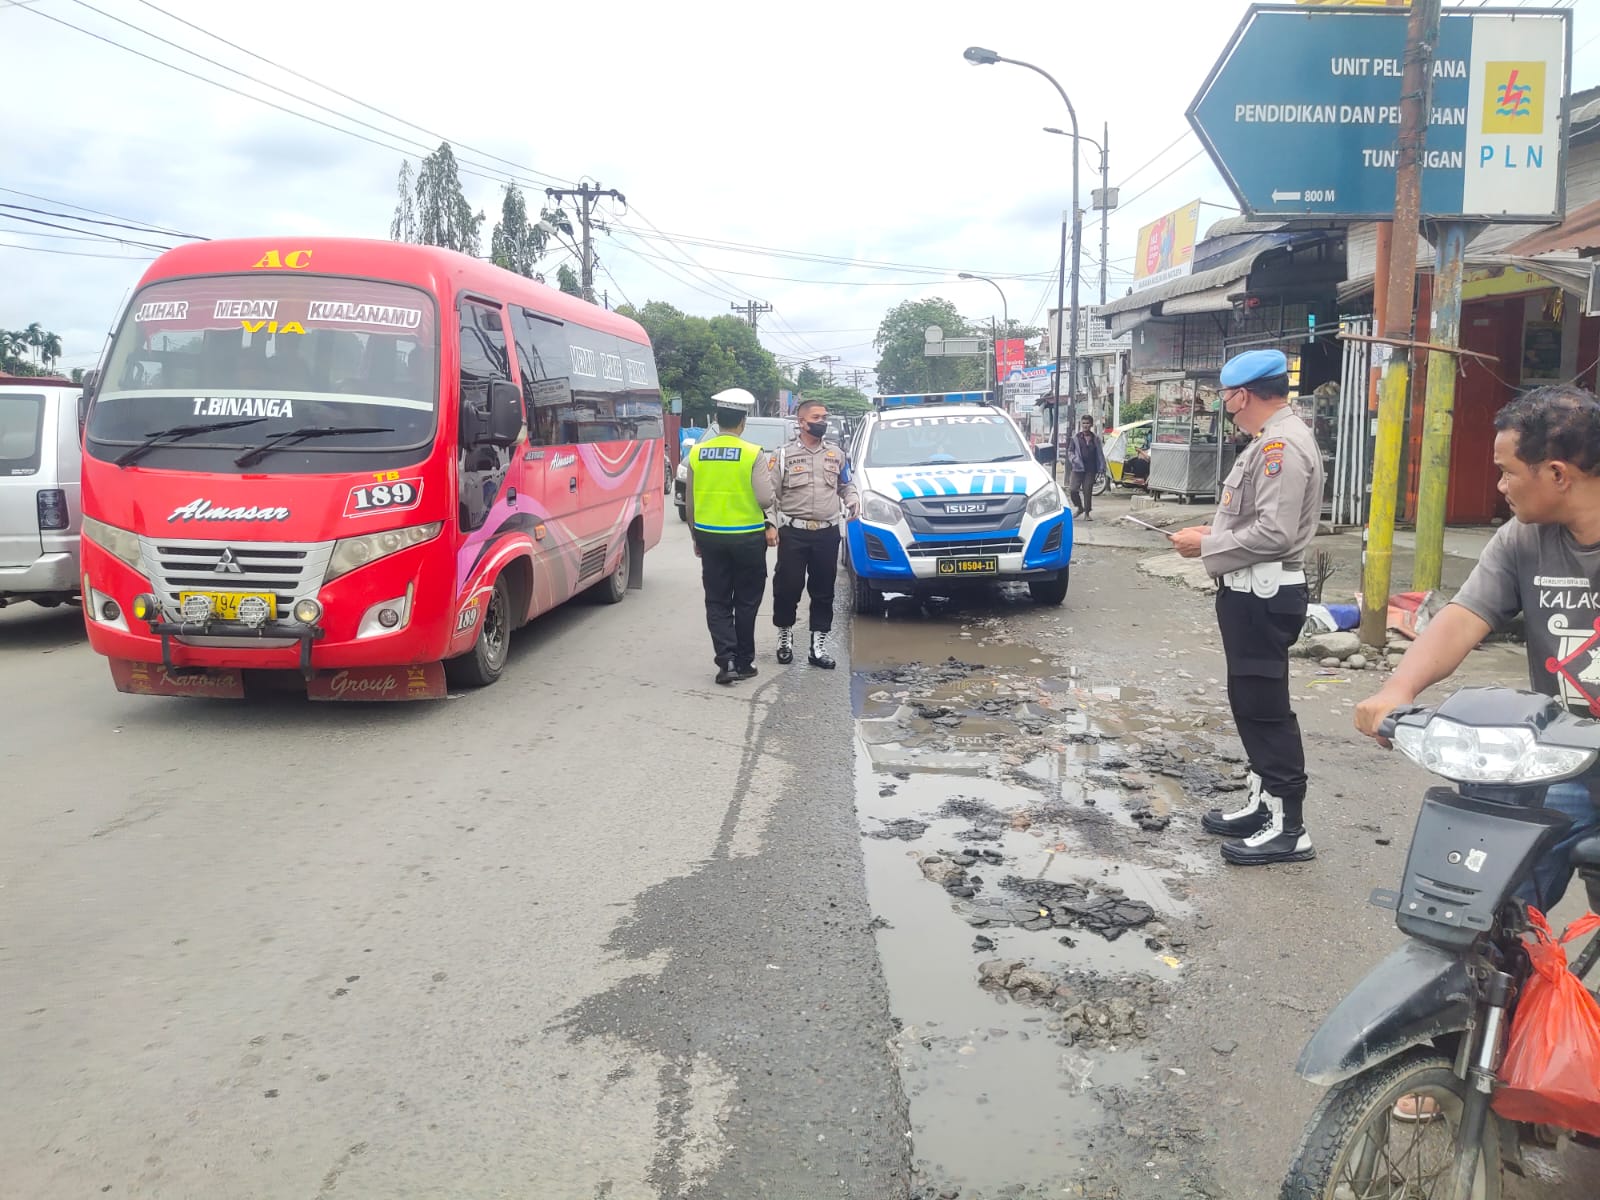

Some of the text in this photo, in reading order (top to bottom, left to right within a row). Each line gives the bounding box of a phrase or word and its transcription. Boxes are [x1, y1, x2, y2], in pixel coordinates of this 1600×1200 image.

[1331, 58, 1467, 78] UNIT PELANA
[1235, 105, 1336, 123] PENDIDIKAN
[1340, 105, 1375, 124] DAN
[1304, 190, 1335, 202] 800 M
[251, 249, 313, 269] AC
[214, 300, 278, 319] MEDAN
[308, 301, 422, 328] KUALANAMU
[241, 320, 306, 335] VIA
[193, 398, 293, 418] T.BINANGA
[890, 416, 993, 429] CITRA
[699, 448, 741, 461] POLISI
[373, 471, 399, 482] TB
[896, 468, 1016, 479] PROVOS
[353, 482, 412, 509] 189
[168, 498, 291, 522] Almasar
[945, 504, 984, 514] ISUZU
[1539, 590, 1600, 609] KALAK
[457, 608, 477, 630] 189
[331, 670, 397, 697] Group
